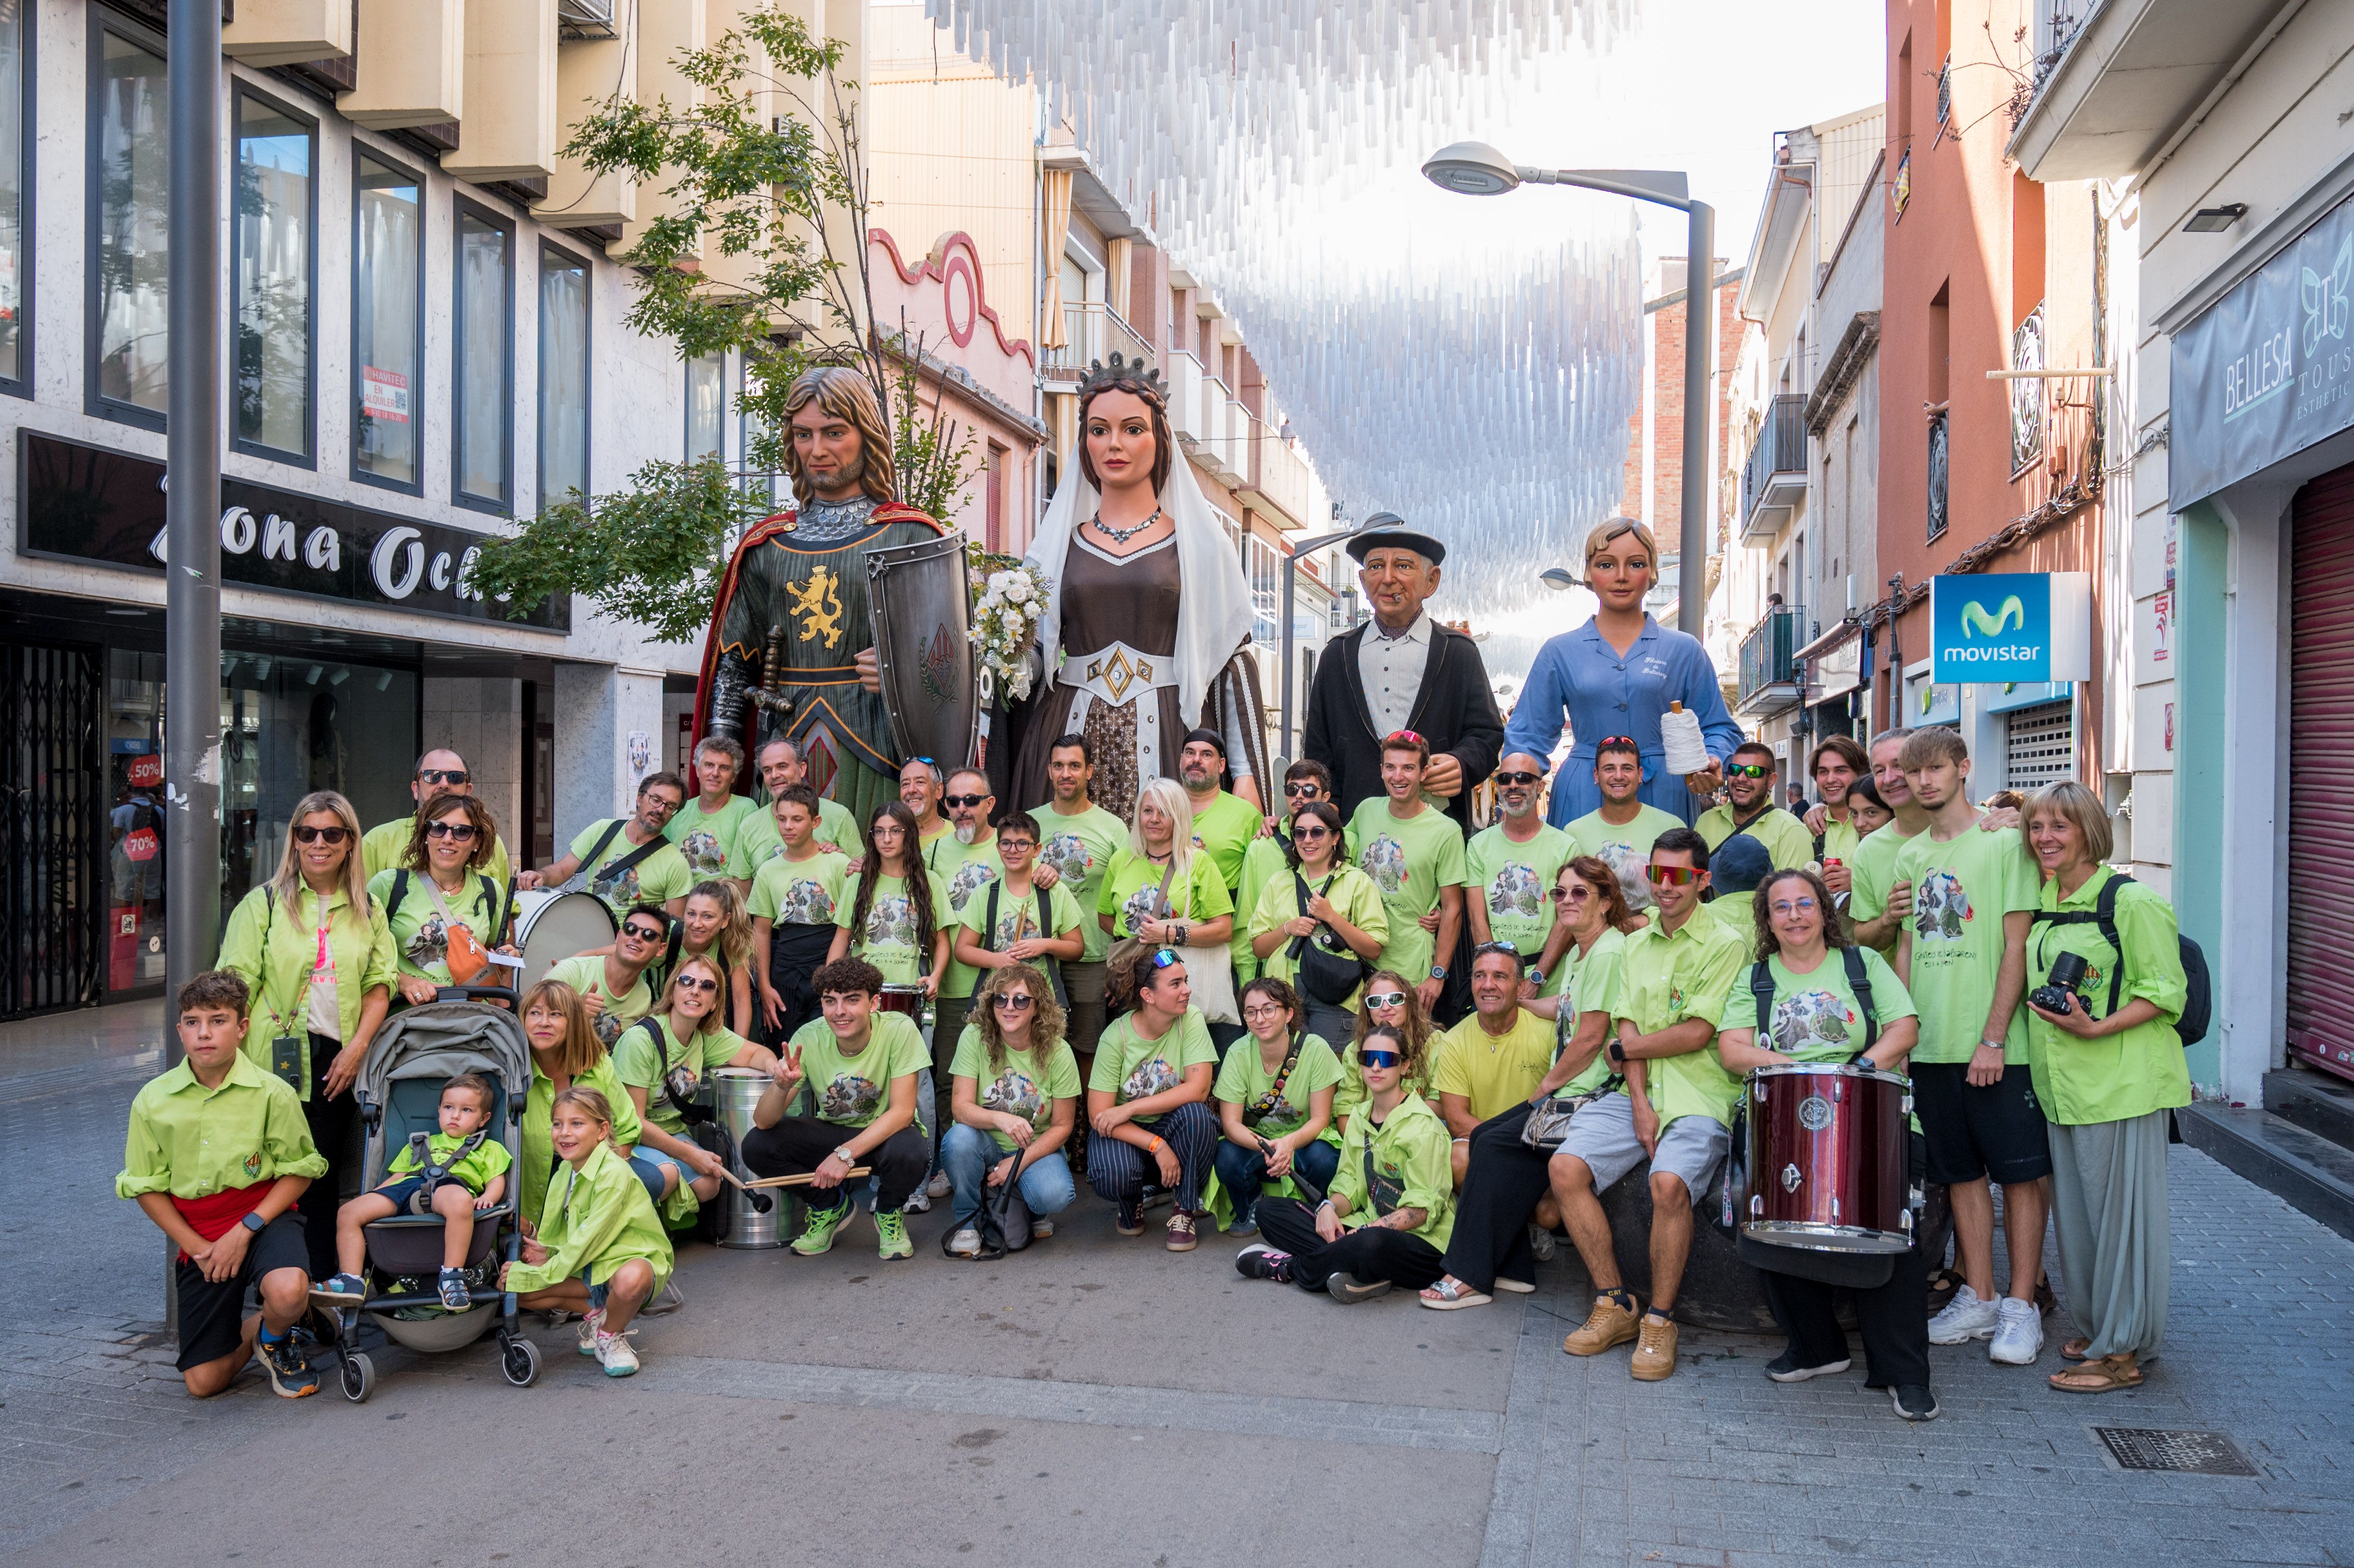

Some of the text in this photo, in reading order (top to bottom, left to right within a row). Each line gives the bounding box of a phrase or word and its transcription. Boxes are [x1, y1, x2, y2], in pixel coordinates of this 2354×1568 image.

[372, 370, 406, 386] HAVITEC
[2225, 326, 2293, 415] BELLESA
[374, 385, 383, 395] EN
[365, 394, 395, 408] ALQUILER
[148, 473, 340, 572] ona
[1944, 645, 2040, 662] movistar
[135, 763, 159, 778] 50%
[130, 836, 154, 852] 70%
